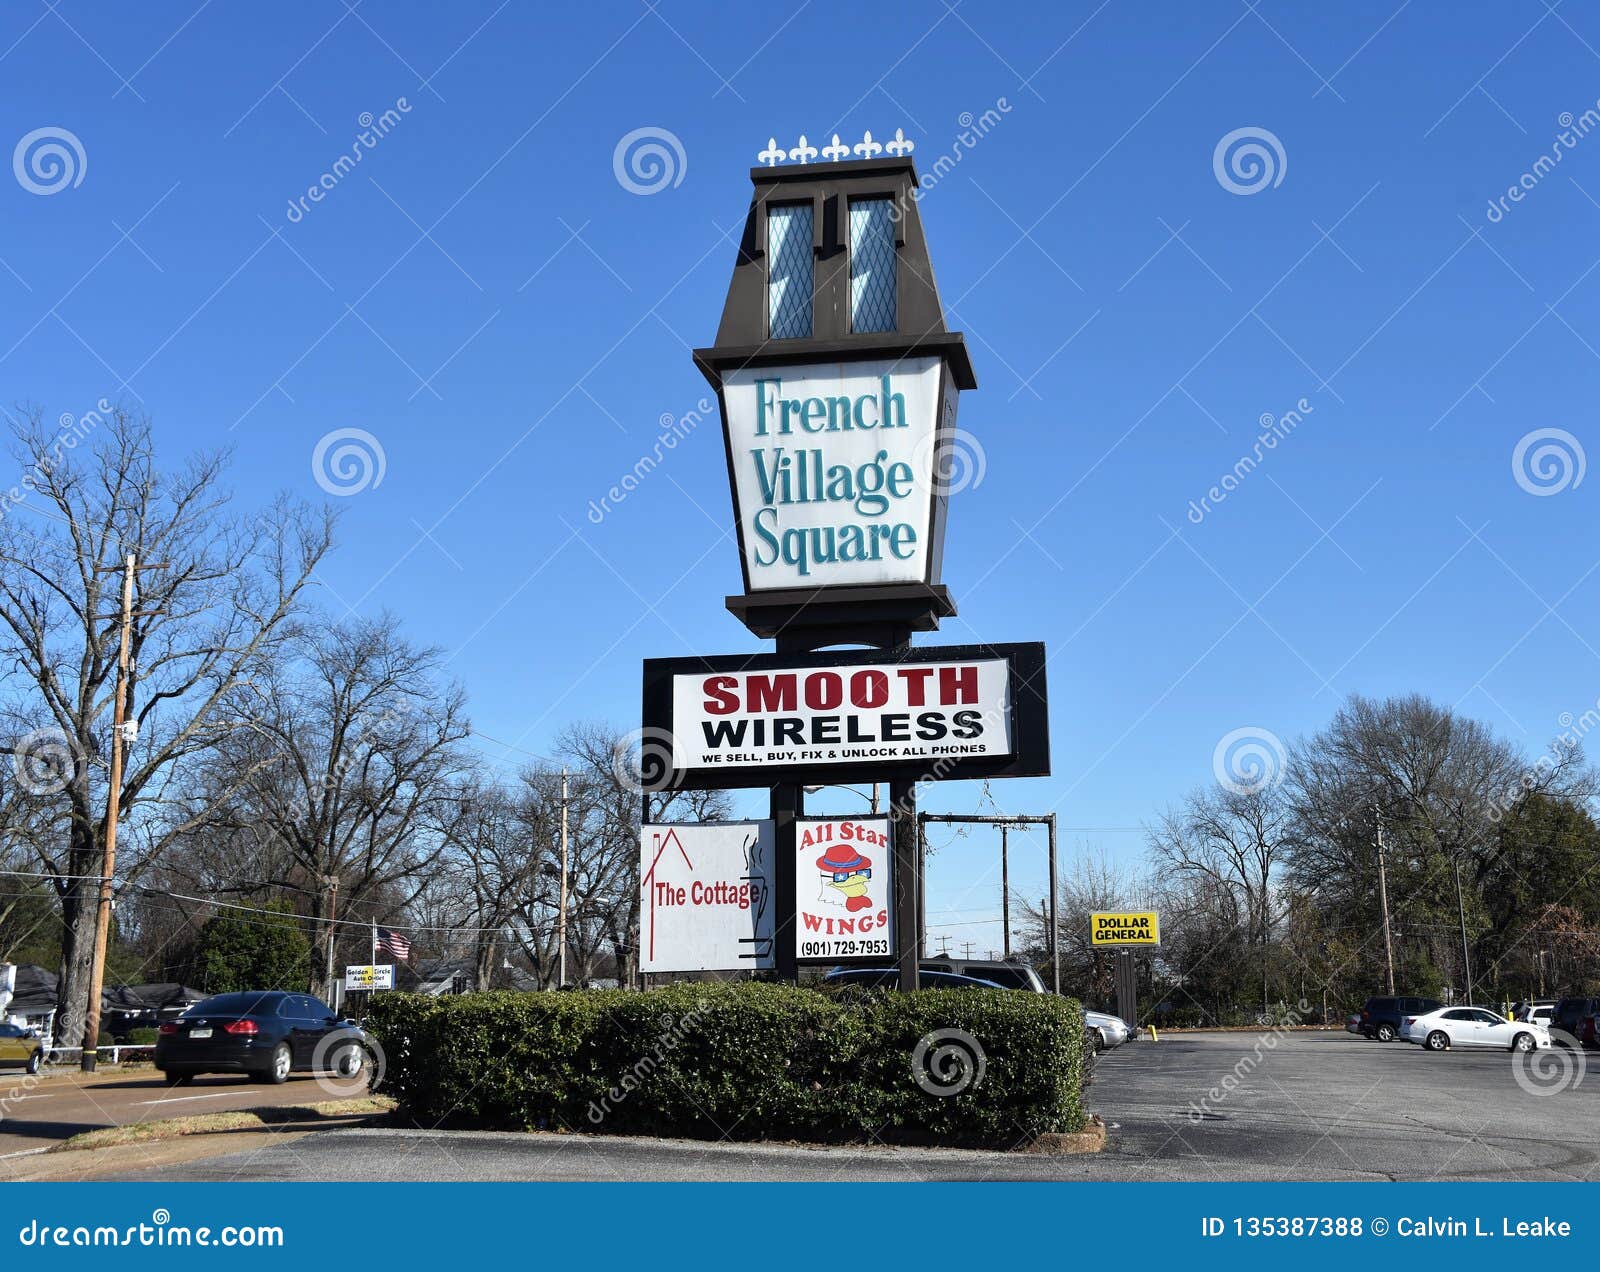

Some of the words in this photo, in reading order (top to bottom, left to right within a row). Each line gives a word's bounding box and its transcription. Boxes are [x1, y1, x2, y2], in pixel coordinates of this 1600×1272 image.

[754, 374, 909, 436] French
[750, 448, 914, 517] Village
[753, 507, 917, 575] Square
[702, 666, 979, 715] SMOOTH
[701, 710, 984, 748] WIRELESS
[702, 754, 722, 763] WE
[726, 753, 763, 763] SELL,
[767, 751, 797, 761] BUY,
[801, 750, 822, 760] FIX
[828, 750, 837, 759] &
[841, 747, 898, 758] UNLOCK
[902, 746, 927, 756] ALL
[932, 744, 987, 754] PHONES
[800, 824, 832, 850] All
[840, 822, 888, 848] Star
[656, 881, 686, 906] The
[691, 880, 760, 909] Cottage
[802, 910, 887, 935] WINGS
[1095, 929, 1153, 940] GENERAL
[1098, 917, 1149, 928] DOLLAR
[801, 941, 831, 956] (901)
[834, 940, 888, 955] 729-7953
